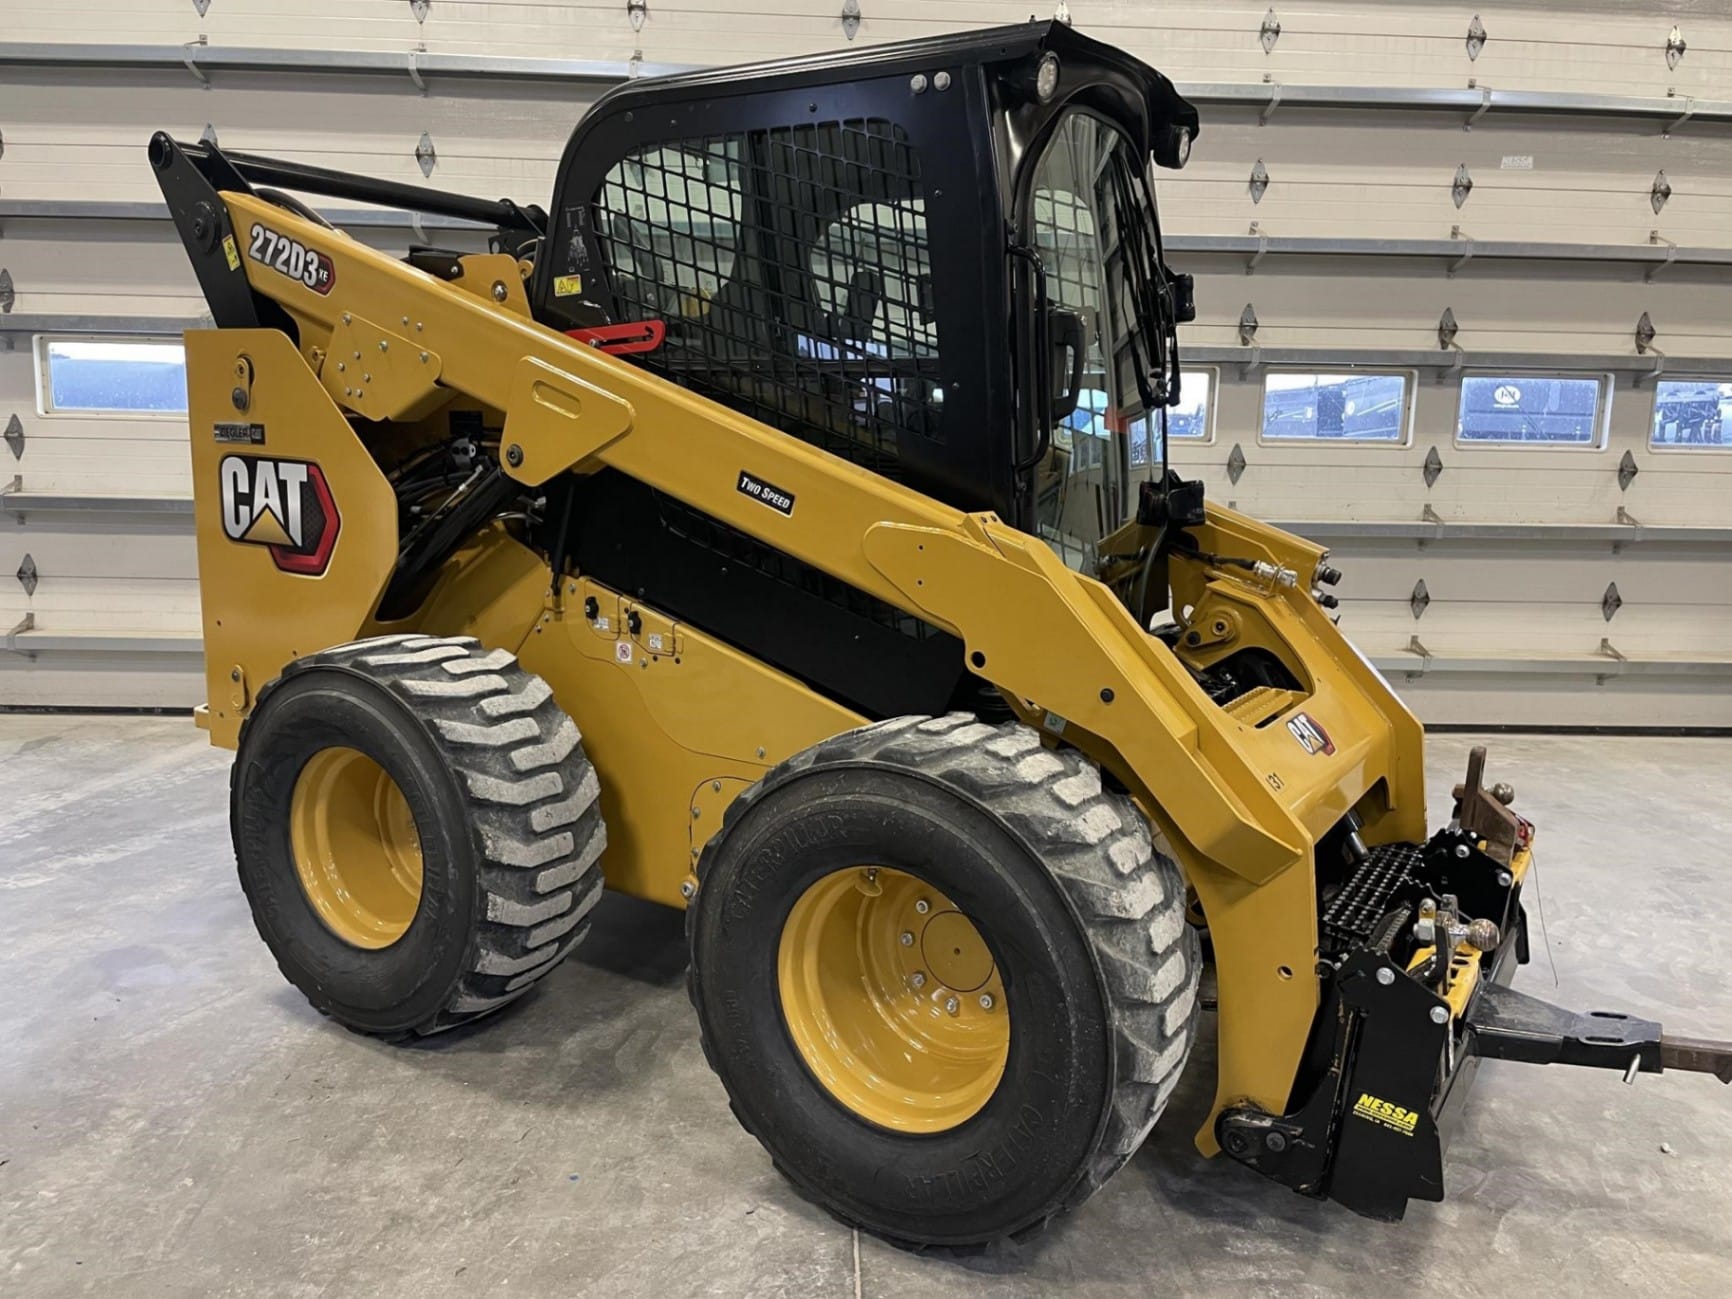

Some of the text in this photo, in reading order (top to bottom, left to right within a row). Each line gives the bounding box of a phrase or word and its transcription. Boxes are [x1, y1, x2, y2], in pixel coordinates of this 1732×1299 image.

[249, 224, 319, 287] 272D3
[221, 456, 308, 548] CAT
[741, 476, 791, 508] TWO SPEED
[1287, 714, 1326, 753] CAT
[1358, 1093, 1419, 1125] NESSA
